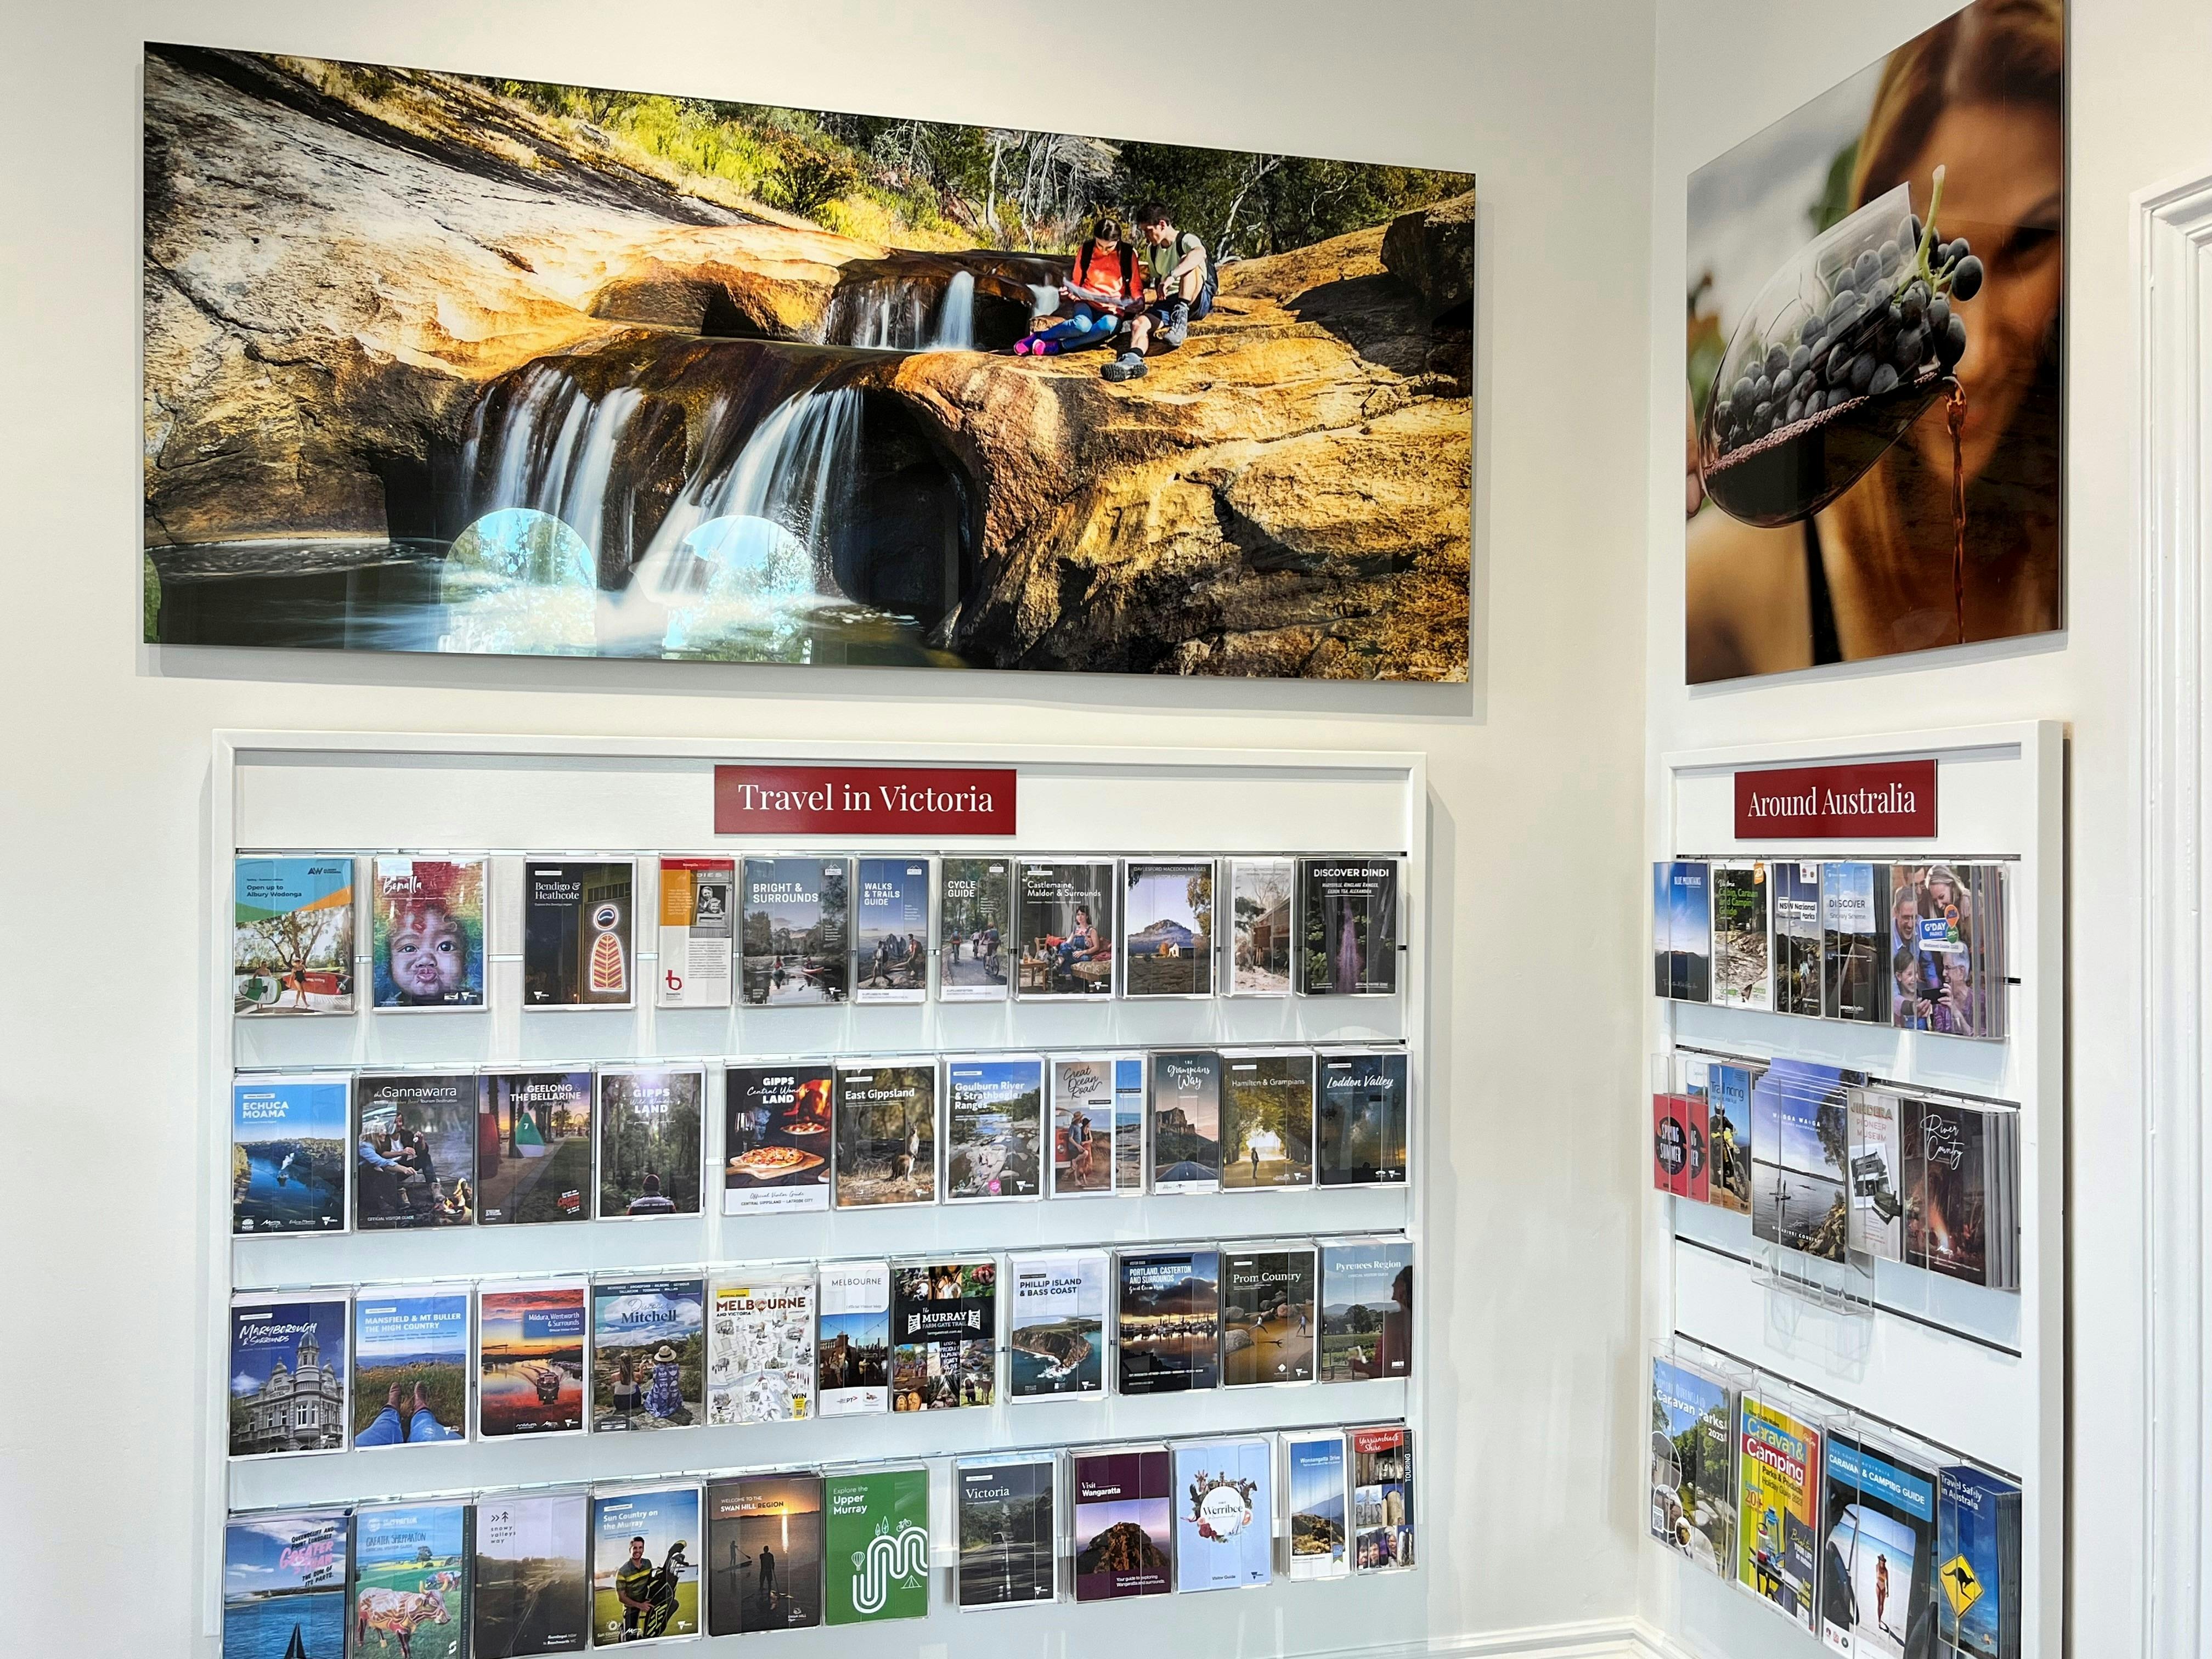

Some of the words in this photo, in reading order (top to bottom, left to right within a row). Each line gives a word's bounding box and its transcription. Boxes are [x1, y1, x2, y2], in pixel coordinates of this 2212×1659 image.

[738, 783, 834, 811] Travel
[843, 784, 872, 811] in
[879, 785, 994, 812] Victoria
[1748, 786, 1817, 816] Around
[1821, 783, 1916, 815] Australia
[1314, 868, 1359, 877] DISCOVER
[1362, 868, 1389, 877] DINDI
[383, 876, 422, 895] Benalla
[535, 882, 570, 891] Bendigo
[572, 882, 581, 890] &
[753, 883, 792, 893] BRIGHT
[795, 883, 803, 891] &
[948, 881, 976, 889] CYCLE
[1028, 881, 1074, 889] Castlemaine,
[535, 891, 579, 899] Heathcote
[753, 893, 819, 903] SURROUNDS
[1737, 888, 1758, 897] Caravan
[1830, 900, 1865, 908] DISCOVER
[1719, 906, 1738, 915] Guide
[1925, 922, 1946, 932] G'DAY
[1063, 1066, 1092, 1081] Great
[763, 1076, 794, 1086] GIPPS
[955, 1082, 998, 1091] Goulburn
[1001, 1081, 1025, 1090] River
[1068, 1075, 1099, 1091] Ocean
[1177, 1075, 1203, 1090] Way
[1269, 1078, 1305, 1087] Grampians
[1327, 1077, 1362, 1089] Loddon
[1363, 1075, 1393, 1089] Valley
[382, 1086, 456, 1097] Gannawarra
[527, 1084, 573, 1093] GEELONG
[633, 1088, 670, 1097] GIPPS
[747, 1086, 777, 1097] Central
[1071, 1081, 1103, 1099] Road
[510, 1093, 529, 1102] THE
[531, 1091, 581, 1101] BELLARINE
[763, 1094, 794, 1104] LAND
[845, 1090, 865, 1101] East
[867, 1088, 915, 1101] Gippsland
[964, 1091, 1019, 1102] Strathbogie
[242, 1102, 289, 1110] ECHUCA
[634, 1104, 668, 1113] LAND
[955, 1101, 988, 1111] Ranges
[1850, 1102, 1893, 1121] JINDERA
[242, 1109, 285, 1119] MOAMA
[1857, 1119, 1887, 1130] PIONEER
[1920, 1114, 1960, 1139] River
[1857, 1130, 1886, 1141] MUSEUM
[1927, 1136, 1965, 1170] Country
[1130, 1267, 1159, 1276] PORTLAND,
[1160, 1266, 1192, 1274] CASTERTON
[1336, 1263, 1372, 1272] Pyrenees
[1374, 1260, 1401, 1270] Region
[832, 1278, 882, 1286] MELBOURNE
[1130, 1276, 1141, 1284] AND
[1142, 1274, 1175, 1284] SURROUNDS
[1233, 1274, 1259, 1283] Prom
[1262, 1272, 1301, 1284] Country
[716, 1297, 806, 1312] MELBOURNE
[365, 1314, 409, 1325] MANSFIELD
[433, 1313, 461, 1321] BULLER
[622, 1310, 676, 1323] Mitchell
[922, 1312, 967, 1323] MURRAY
[381, 1323, 401, 1331] HIGH
[404, 1322, 439, 1330] COUNTRY
[242, 1338, 249, 1346] &
[1657, 1389, 1695, 1415] Caravan
[1698, 1408, 1725, 1430] Parks
[1359, 1434, 1400, 1446] Yarriambiack
[1708, 1427, 1725, 1442] 2023
[1748, 1418, 1795, 1454] Caravan
[1796, 1442, 1804, 1462] &
[1364, 1443, 1381, 1452] Shire
[1747, 1437, 1804, 1486] Camping
[1762, 1465, 1777, 1480] Parks
[1784, 1476, 1803, 1496] Products
[1762, 1476, 1778, 1492] Holiday
[1829, 1454, 1859, 1474] CARAVAN
[1862, 1469, 1867, 1478] &
[1869, 1472, 1901, 1493] CAMPING
[1903, 1488, 1925, 1505] GUIDE
[966, 1486, 1009, 1499] Victoria
[1082, 1487, 1121, 1497] Wangaratta
[1940, 1474, 1961, 1490] Travel
[1962, 1483, 1982, 1502] Safely
[1941, 1485, 1948, 1496] in
[758, 1501, 783, 1509] REGION
[833, 1495, 864, 1506] Upper
[833, 1504, 867, 1515] Murray
[1203, 1504, 1243, 1515] Werribee
[619, 1511, 647, 1521] Country
[617, 1520, 644, 1529] Murray
[366, 1536, 390, 1547] GREATER
[391, 1532, 426, 1544] SHEPPARTON
[302, 1573, 311, 1582] THE
